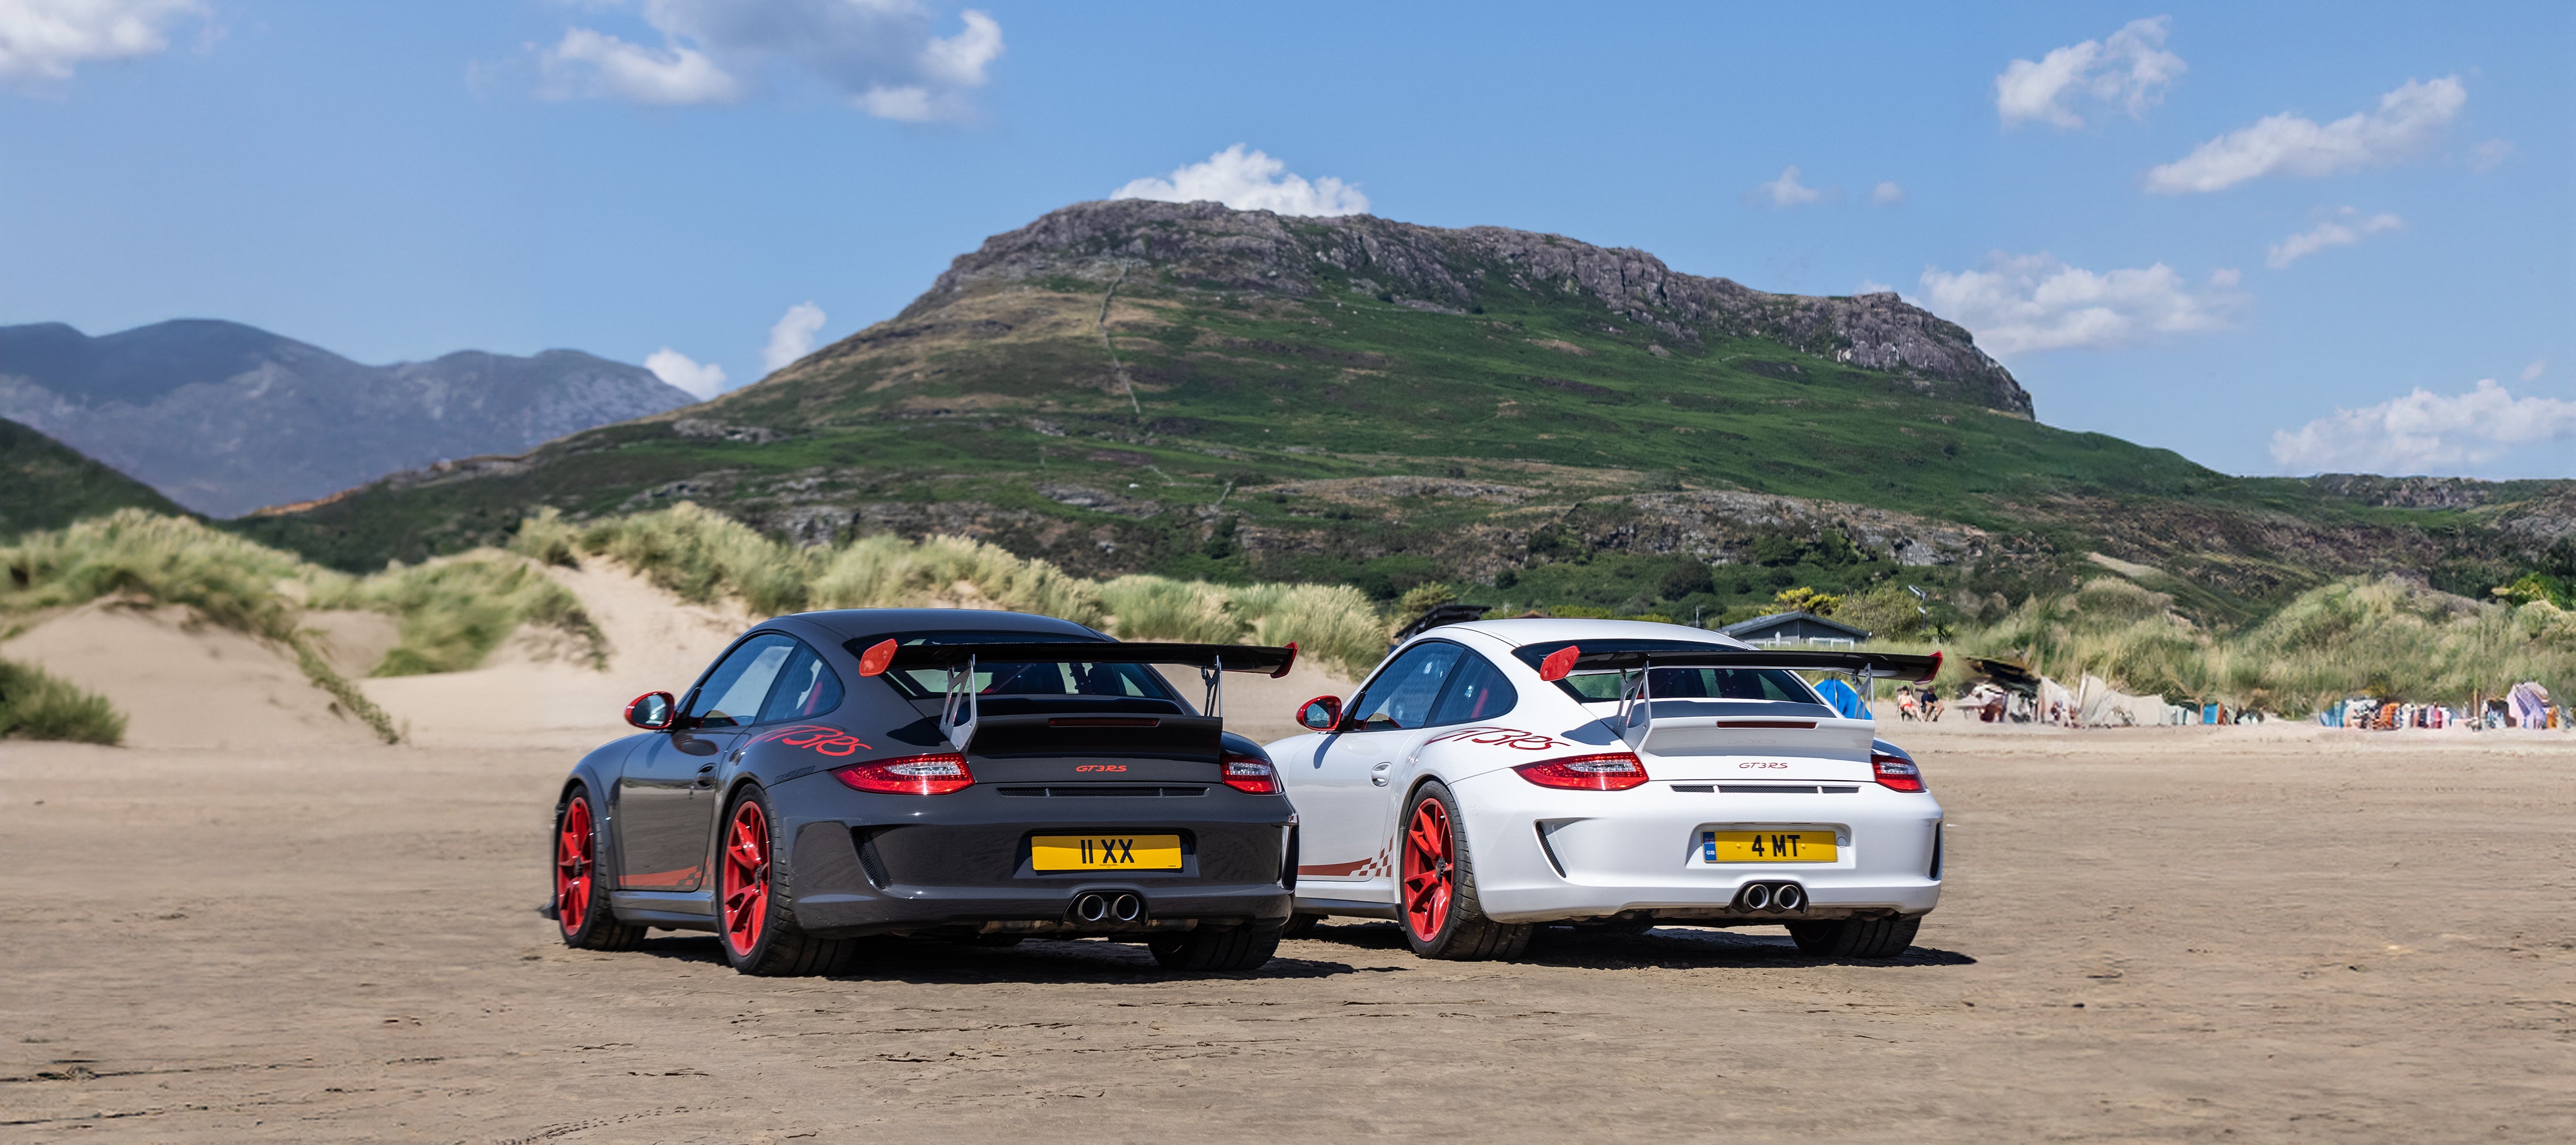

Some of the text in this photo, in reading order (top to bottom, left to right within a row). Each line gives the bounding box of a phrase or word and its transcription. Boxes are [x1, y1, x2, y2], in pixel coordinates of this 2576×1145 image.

[1101, 838, 1135, 864] XX
[1751, 834, 1801, 857] 4 MT
